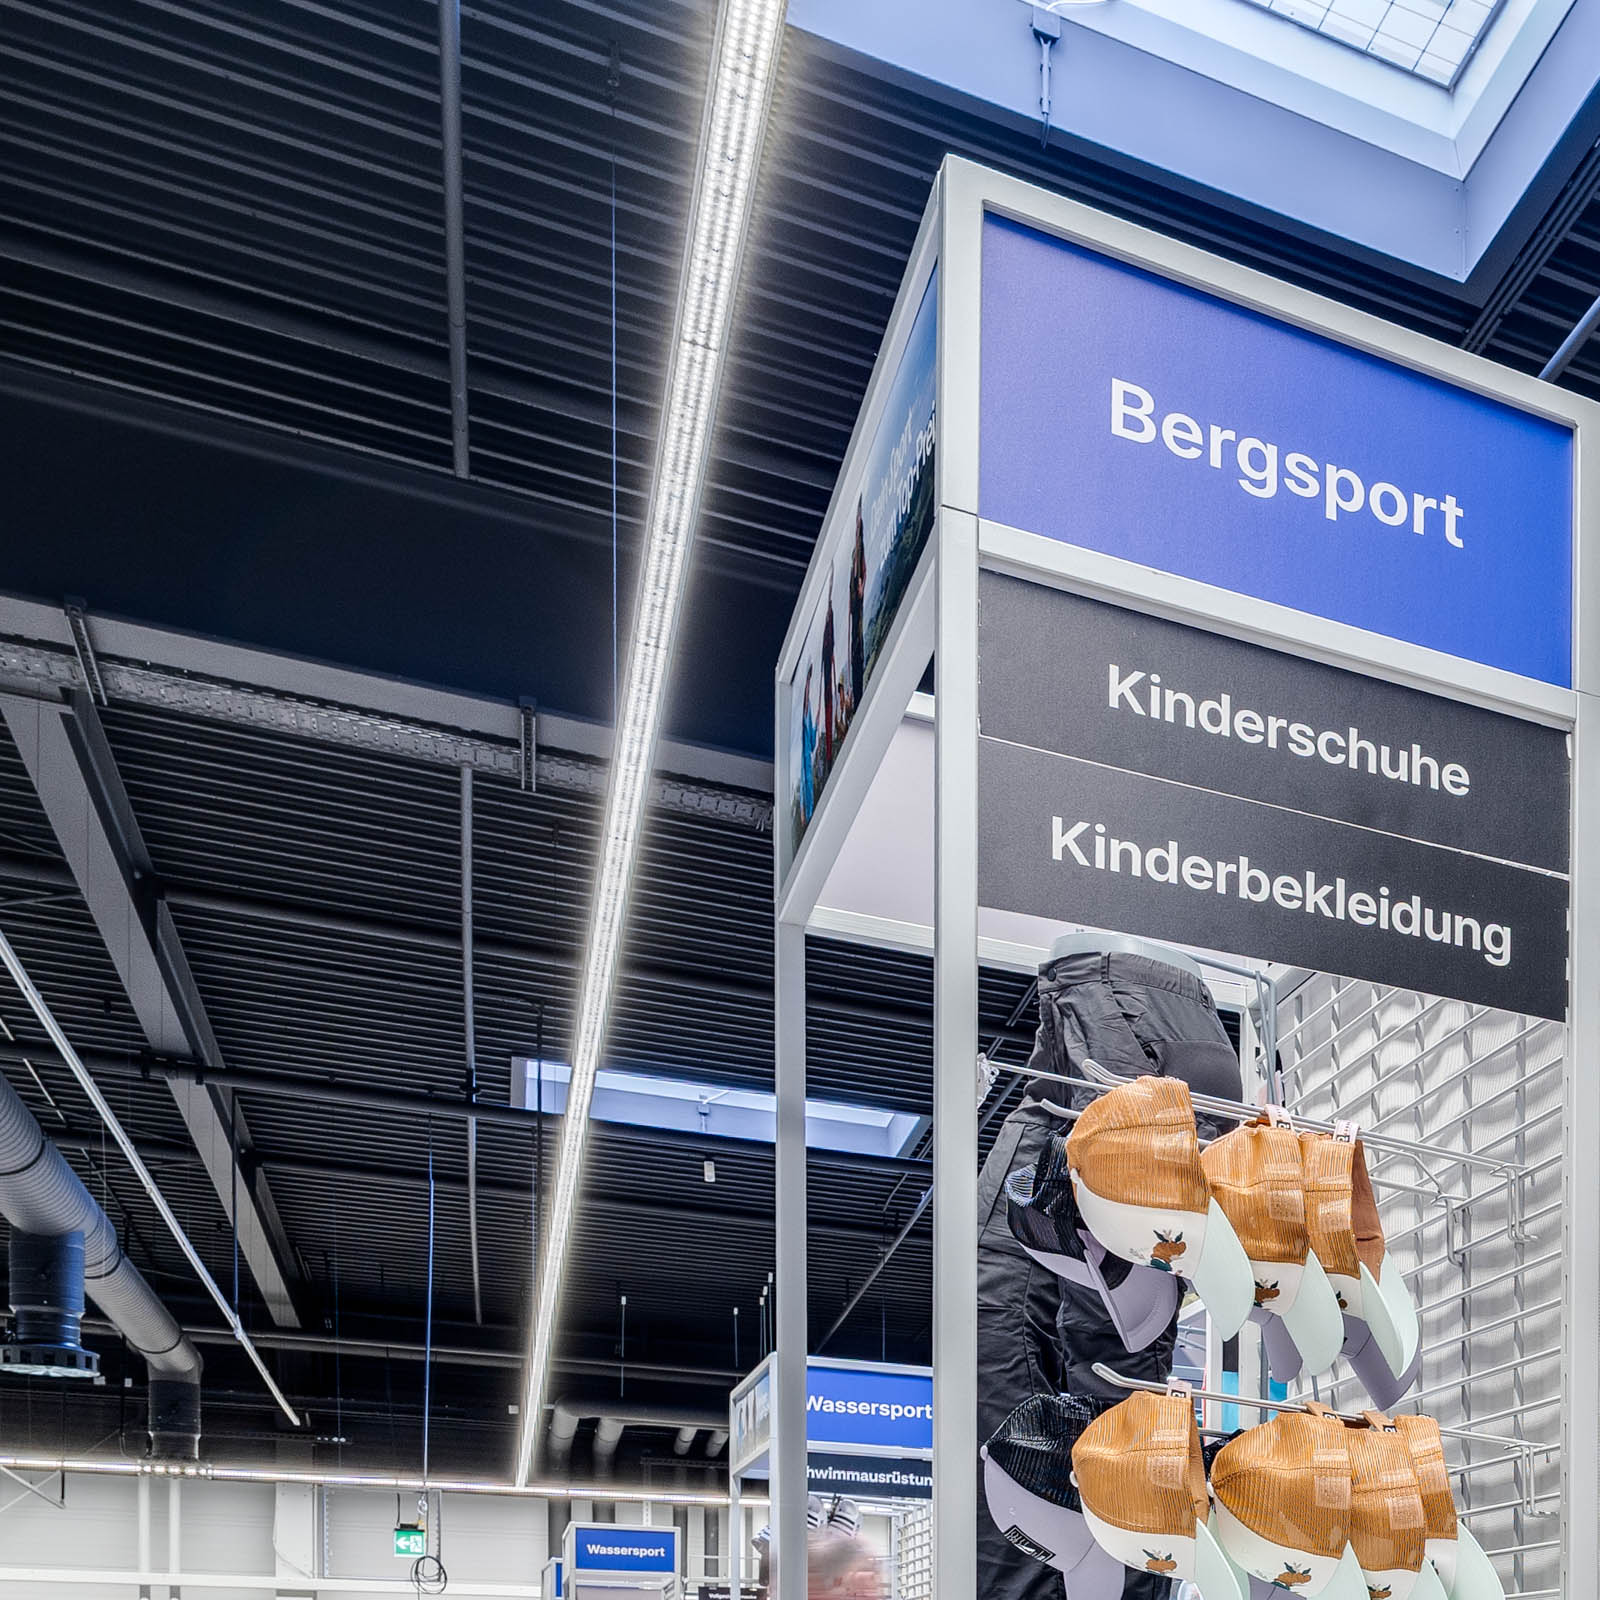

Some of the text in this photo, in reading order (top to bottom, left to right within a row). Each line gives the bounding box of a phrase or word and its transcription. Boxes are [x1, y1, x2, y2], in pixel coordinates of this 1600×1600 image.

[898, 399, 936, 523] Top-Prei
[1111, 377, 1464, 549] Bergsport
[1108, 664, 1471, 797] Kinderschuhe
[1052, 815, 1513, 968] Kinderbekleidung
[806, 1395, 933, 1420] Wassersport
[806, 1466, 933, 1488] hwimmausrüstun
[586, 1543, 665, 1558] Wassersport
